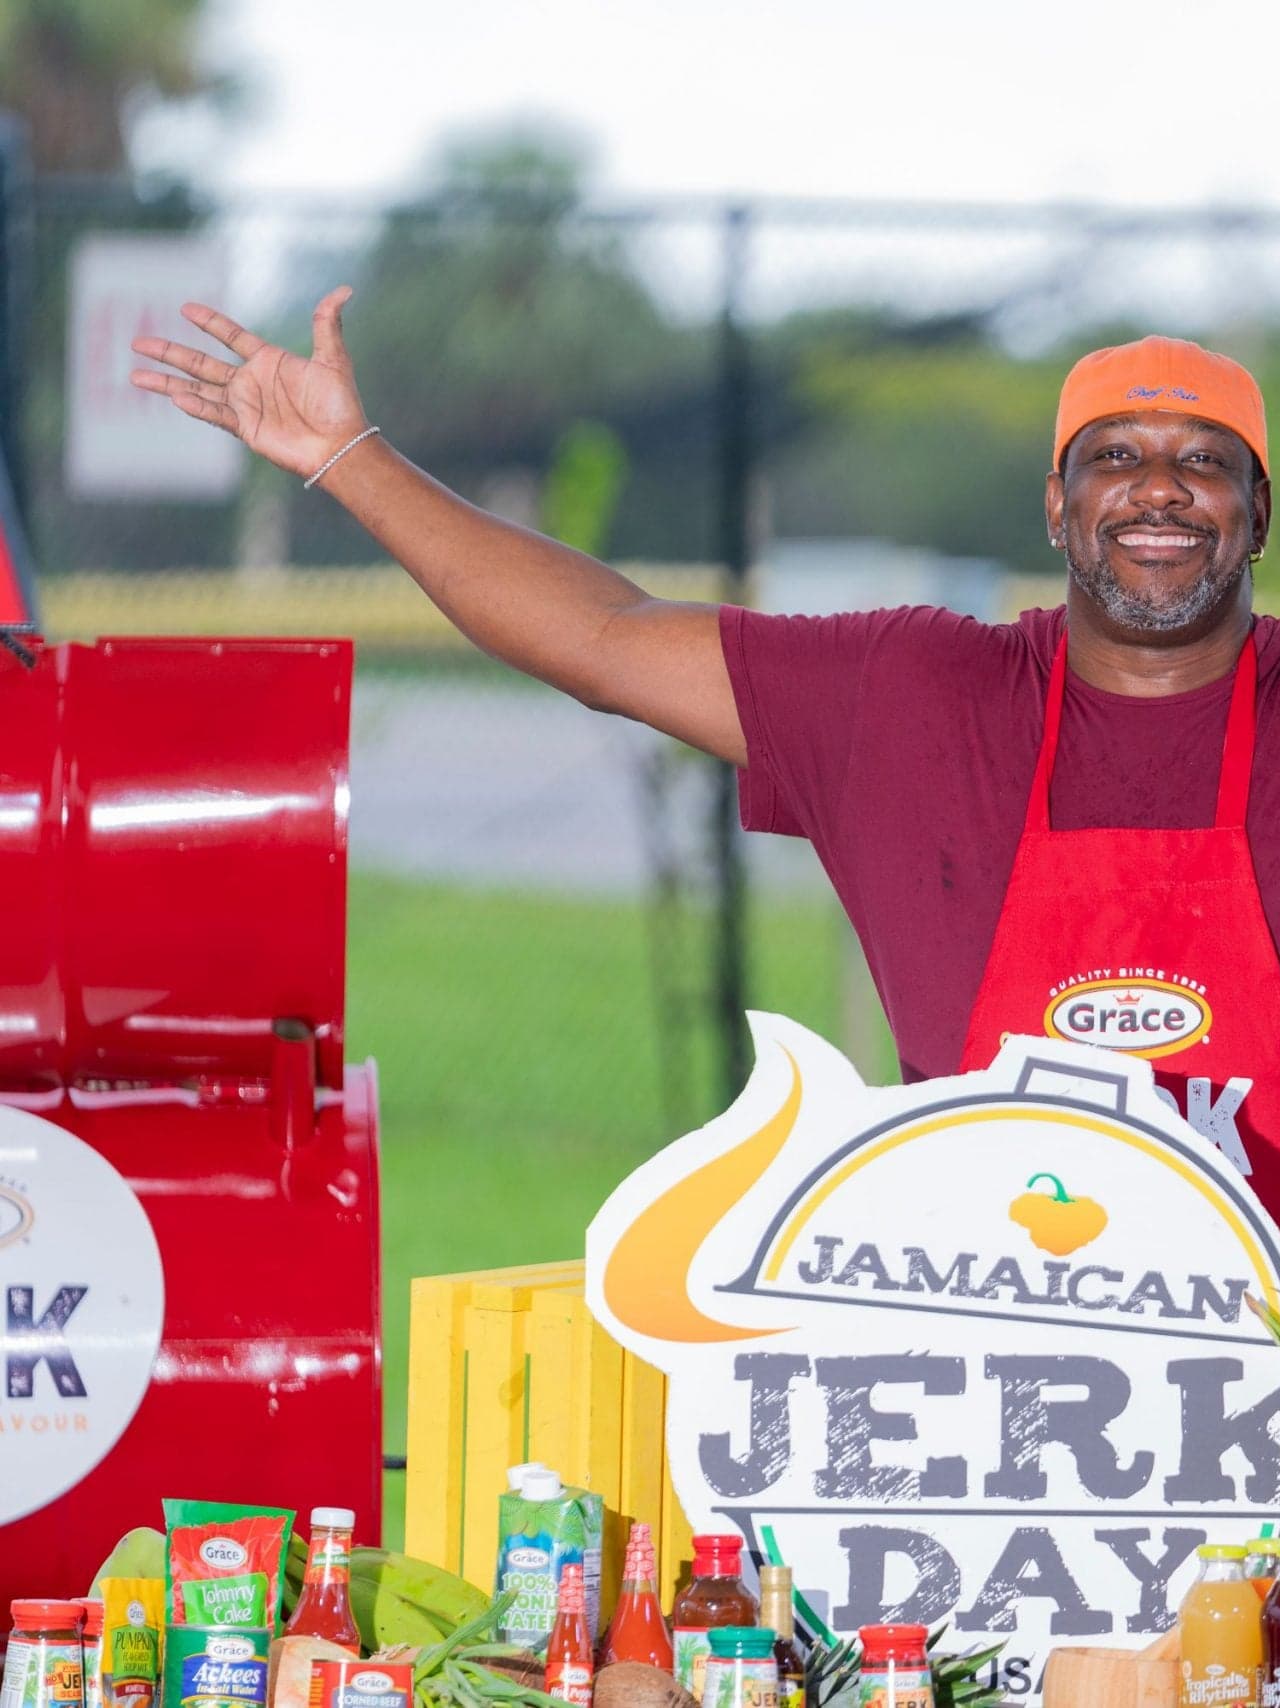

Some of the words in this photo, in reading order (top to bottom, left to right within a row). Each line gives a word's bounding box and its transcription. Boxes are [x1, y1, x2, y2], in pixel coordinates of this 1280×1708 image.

[1049, 968, 1111, 997] QUALITY
[1119, 967, 1165, 980] SINCE
[1067, 1002, 1186, 1033] Grace
[798, 1235, 1249, 1323] JAMAICAN
[205, 1546, 240, 1561] Grace
[513, 1552, 545, 1563] Grace
[502, 1572, 558, 1592] 100%
[832, 1523, 1207, 1639] DAY
[202, 1583, 256, 1607] Johnny
[213, 1603, 252, 1624] Cake
[213, 1645, 249, 1656] Grace
[191, 1661, 261, 1685] Ackees
[1185, 1671, 1234, 1693] Tropical
